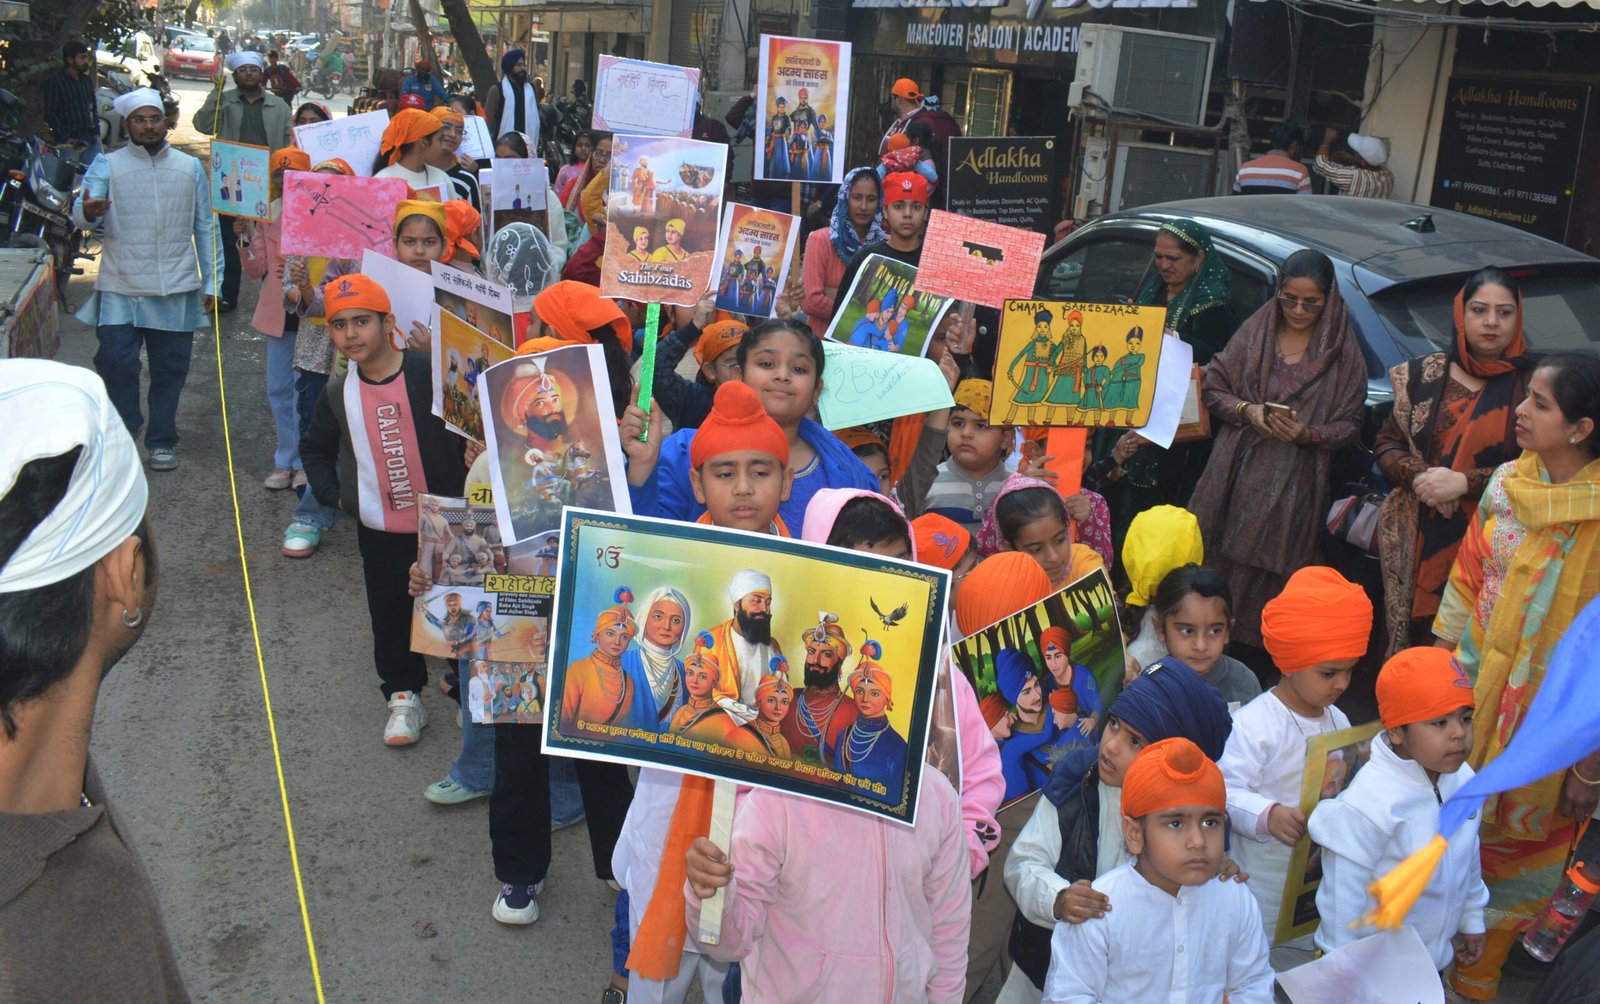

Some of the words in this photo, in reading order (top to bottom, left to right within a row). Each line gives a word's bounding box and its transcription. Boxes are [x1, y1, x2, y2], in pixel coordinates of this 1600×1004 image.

[906, 23, 963, 47] MAKEOVER
[973, 24, 1013, 49] SALON
[776, 66, 802, 78] अदम्य
[803, 69, 828, 80] साहस
[1451, 86, 1501, 106] Adlakha
[1504, 88, 1578, 111] Handlooms
[955, 146, 1041, 175] Adlakha
[986, 171, 1048, 184] Handlooms
[1451, 181, 1462, 189] +91
[1503, 189, 1515, 198] +91
[999, 207, 1008, 215] Top
[1523, 213, 1537, 224] LLP
[738, 226, 759, 238] अदम्य
[760, 230, 780, 241] साहस
[640, 262, 652, 270] The
[654, 263, 674, 273] Four
[618, 269, 692, 289] Sāhibzādās
[1009, 300, 1047, 315] CHAAR
[1062, 302, 1140, 320] SAHIBZAADE
[376, 404, 417, 511] CALIFORNIA
[539, 577, 556, 594] दि
